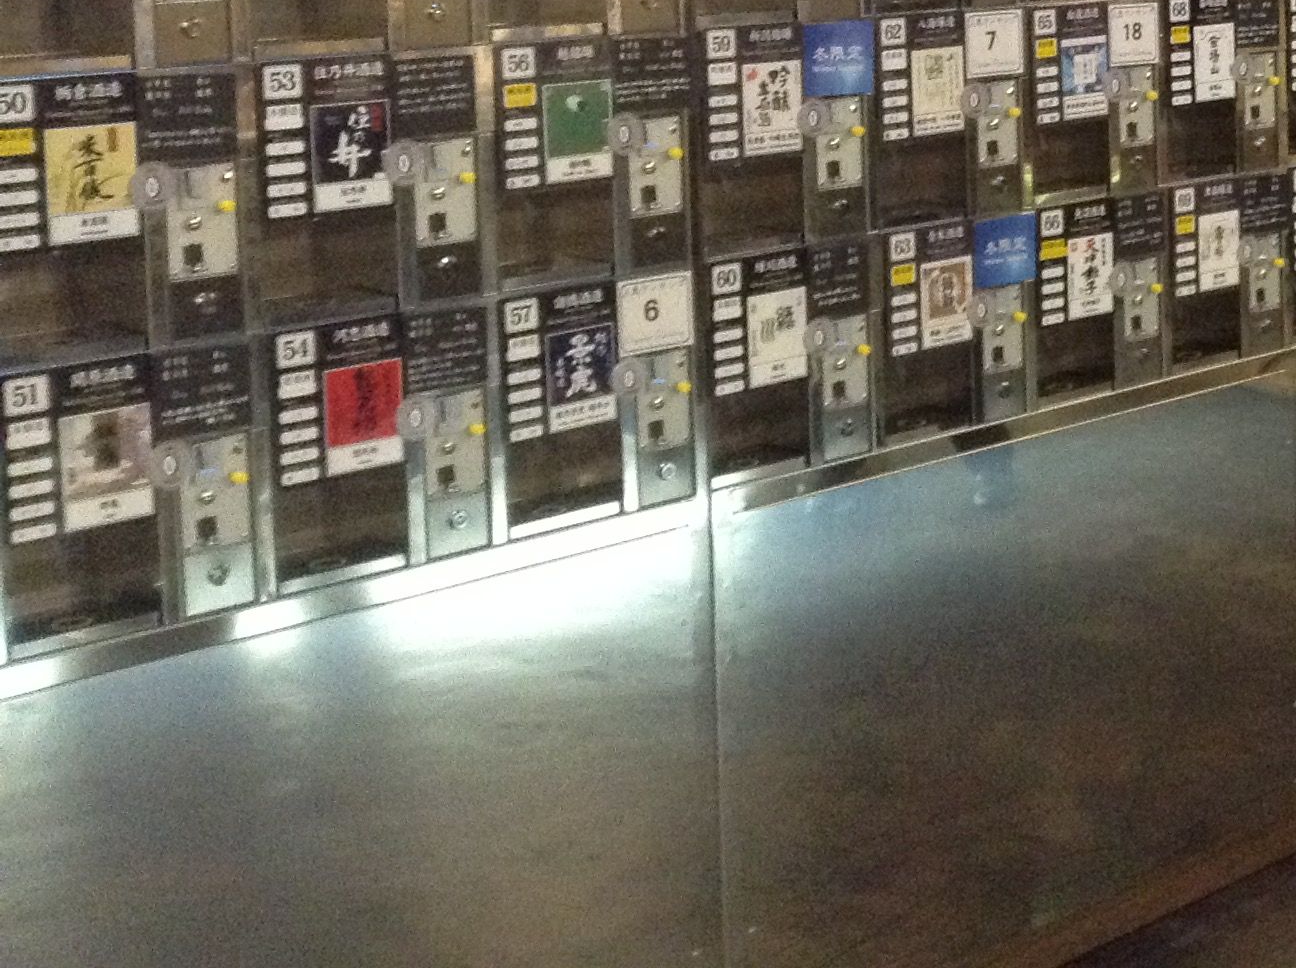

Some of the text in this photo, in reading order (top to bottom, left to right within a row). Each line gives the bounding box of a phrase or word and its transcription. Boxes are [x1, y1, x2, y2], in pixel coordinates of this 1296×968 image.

[884, 24, 902, 40] 62
[985, 30, 998, 51] 7
[1123, 21, 1143, 42] 18
[711, 34, 731, 53] 59
[507, 54, 530, 73] 56
[269, 71, 295, 93] 53
[716, 269, 738, 289] 60
[510, 305, 532, 326] 57
[644, 299, 660, 322] 6
[282, 340, 309, 361] 54
[12, 383, 39, 408] 51
